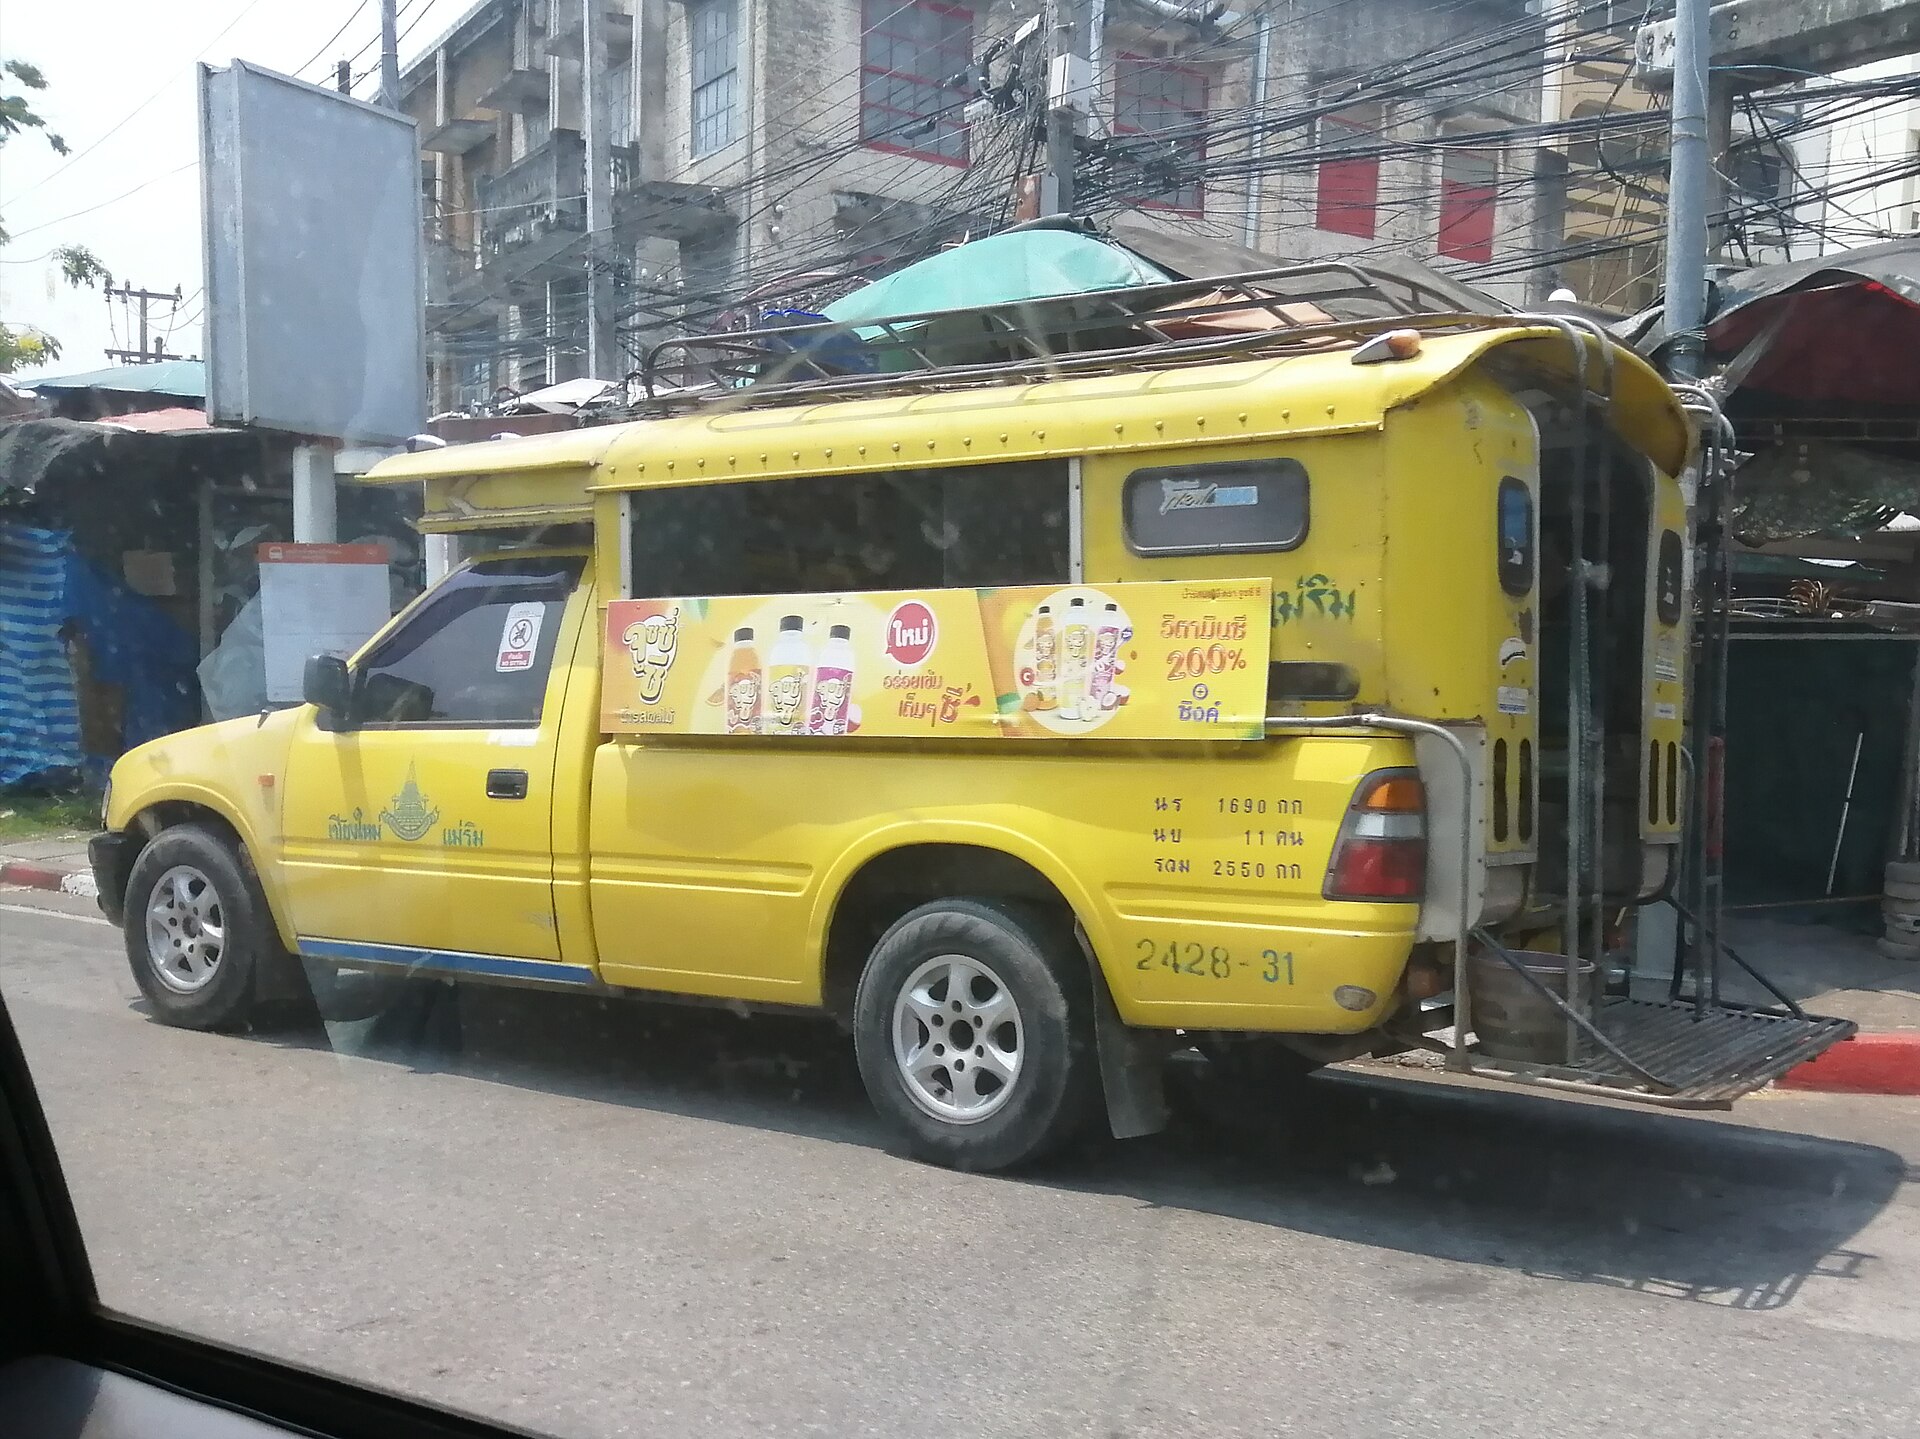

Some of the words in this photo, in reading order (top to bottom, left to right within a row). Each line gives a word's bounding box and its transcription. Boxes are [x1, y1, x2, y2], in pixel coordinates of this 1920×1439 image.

[1271, 573, 1356, 627] ม่ริม
[892, 618, 928, 647] ใหม่
[1160, 614, 1247, 640] วิตามินซี
[1166, 643, 1247, 681] 200%
[898, 692, 936, 727] เต็มๆ
[1218, 798, 1266, 814] 1690
[1277, 799, 1303, 815] กก
[442, 819, 484, 847] แม่ริม
[1244, 829, 1265, 846] 11
[1276, 830, 1304, 846] คน
[1154, 858, 1190, 873] รวม
[1213, 859, 1266, 878] 2550
[1276, 863, 1302, 879] กก
